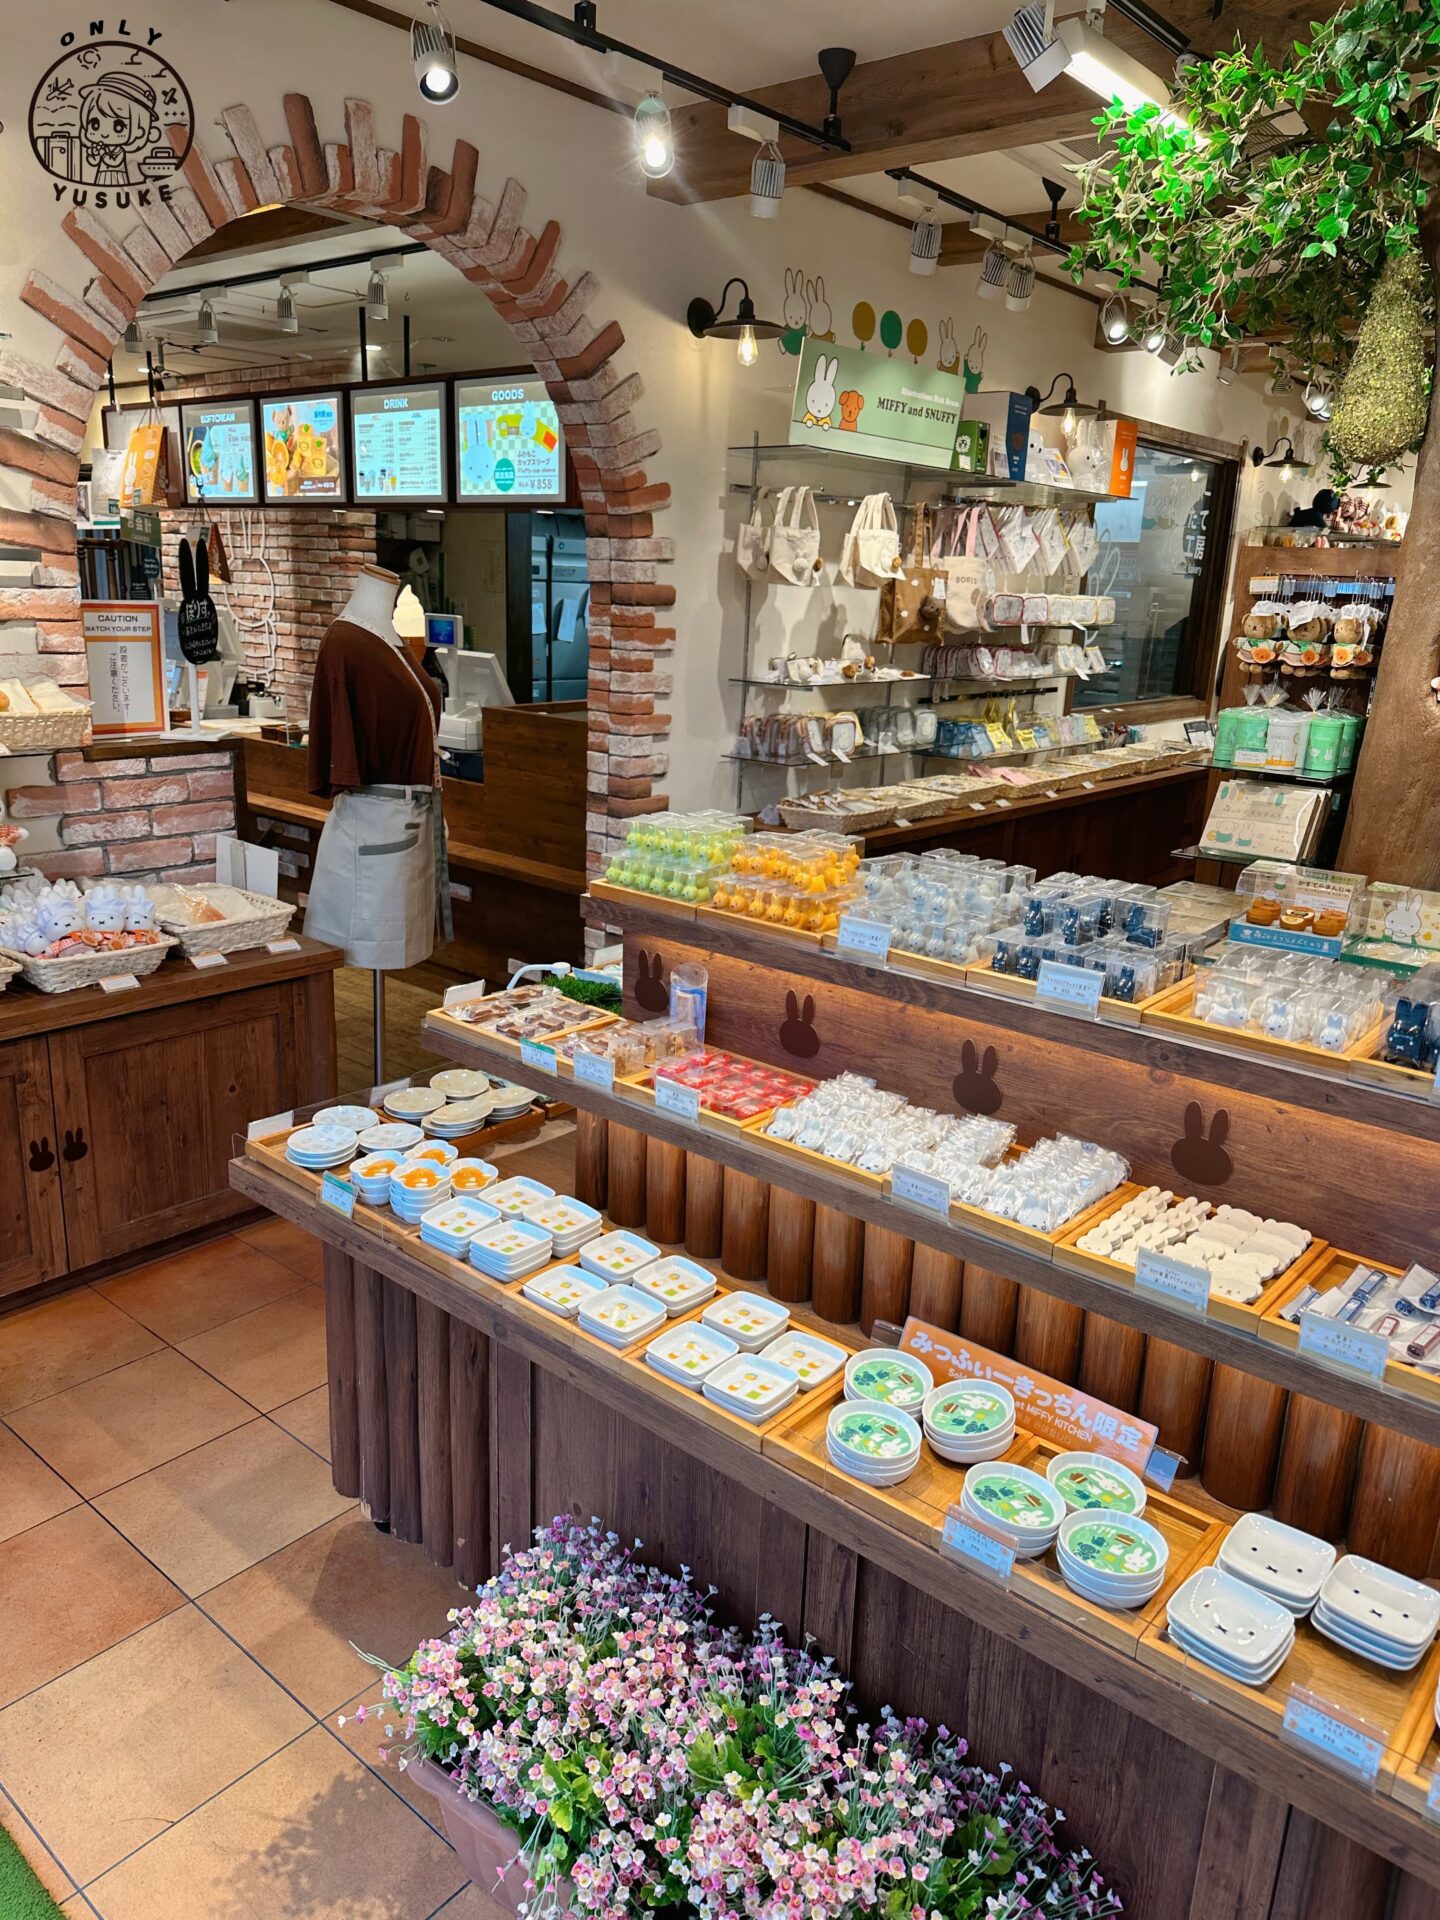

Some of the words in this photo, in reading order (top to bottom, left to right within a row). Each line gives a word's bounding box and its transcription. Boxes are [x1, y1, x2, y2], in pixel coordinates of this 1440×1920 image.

[491, 388, 525, 401] GOODS
[383, 397, 409, 410] DRINK
[876, 396, 907, 414] MIFFY
[907, 405, 923, 418] and
[924, 407, 958, 425] SNUFFY
[530, 478, 553, 490] ¥858
[97, 614, 138, 623] CAUTION
[1026, 1402, 1054, 1423] MIFFY
[1055, 1418, 1093, 1443] KITCHEN
